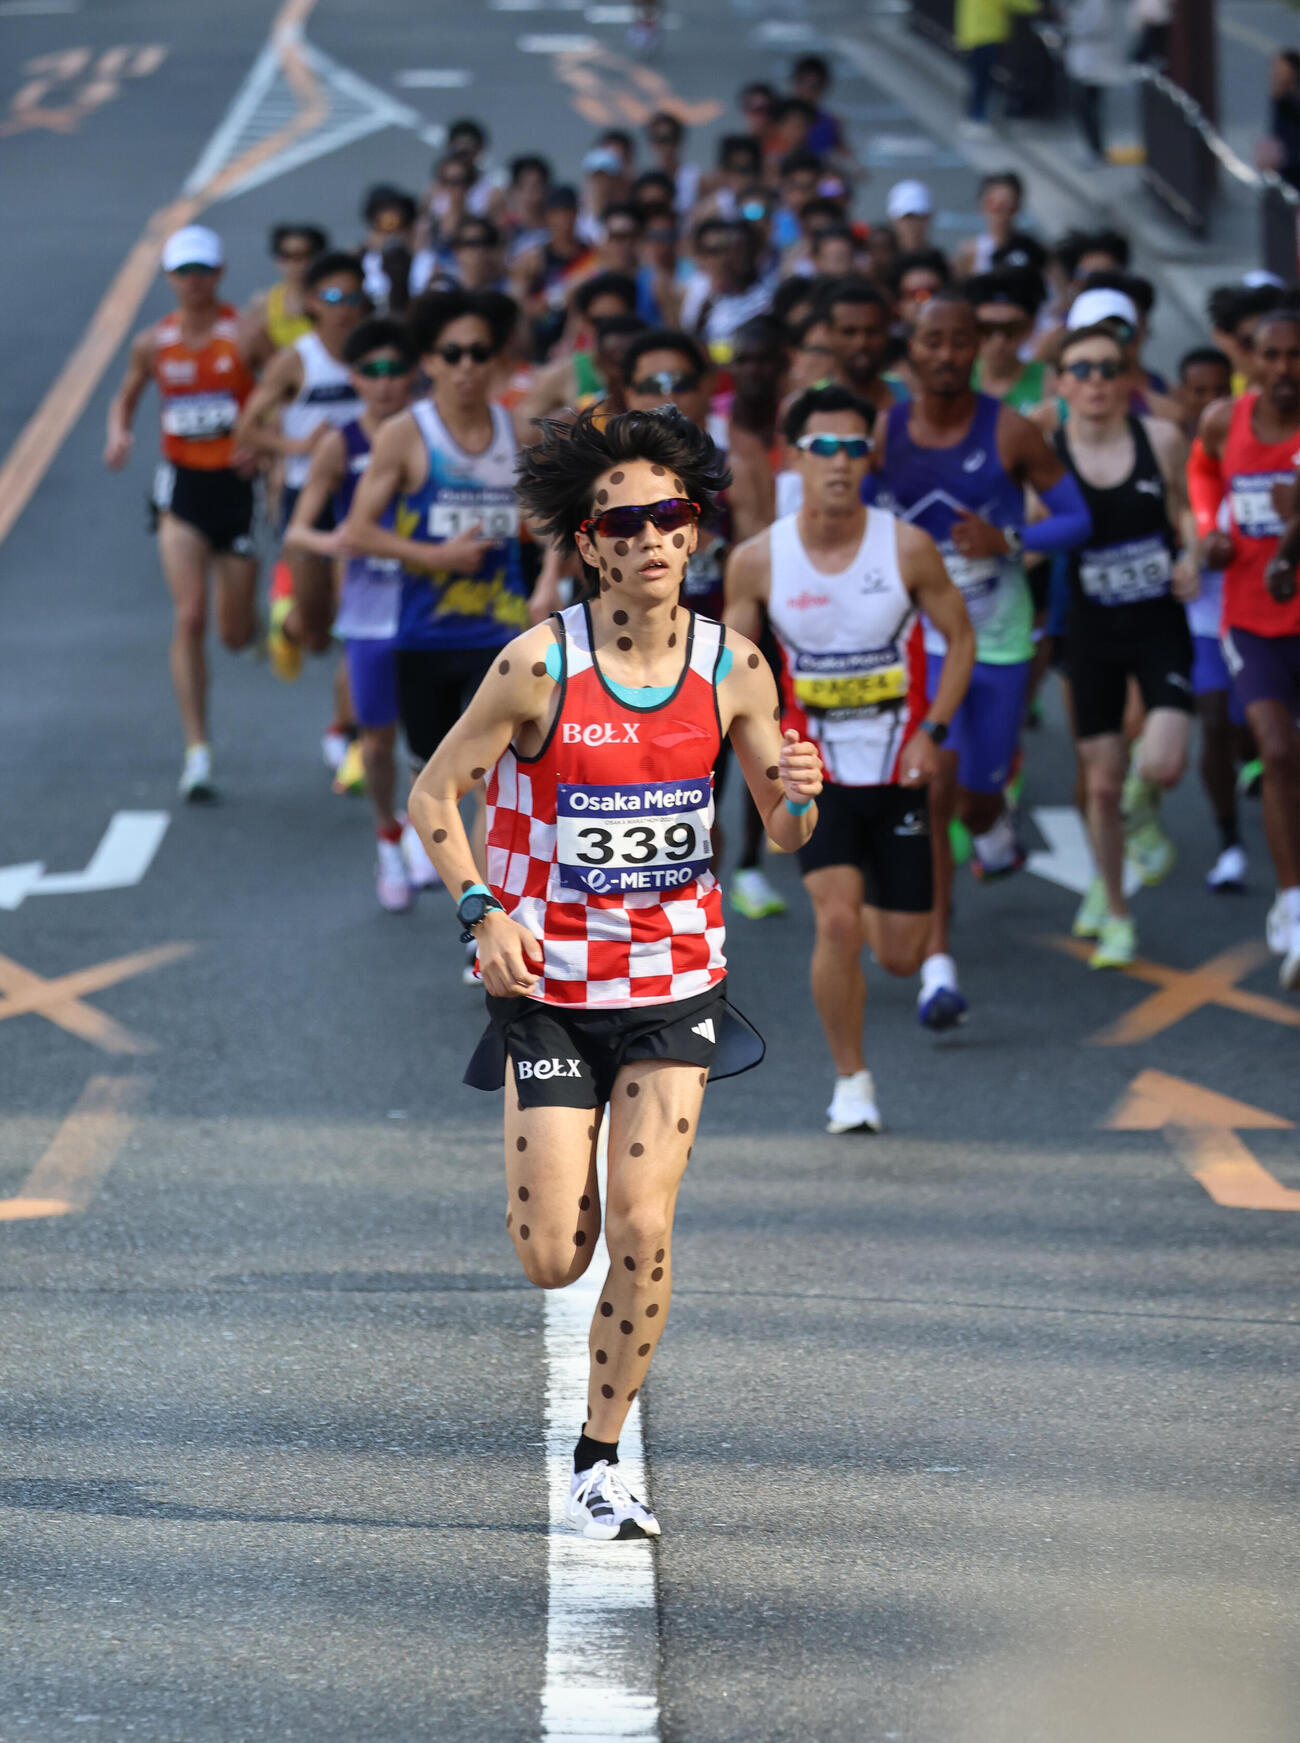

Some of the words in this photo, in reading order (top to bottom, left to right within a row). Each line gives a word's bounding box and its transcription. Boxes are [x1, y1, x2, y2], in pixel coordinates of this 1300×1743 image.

[569, 792, 641, 811] Osaka
[644, 789, 703, 809] Metro
[576, 822, 697, 865] 339
